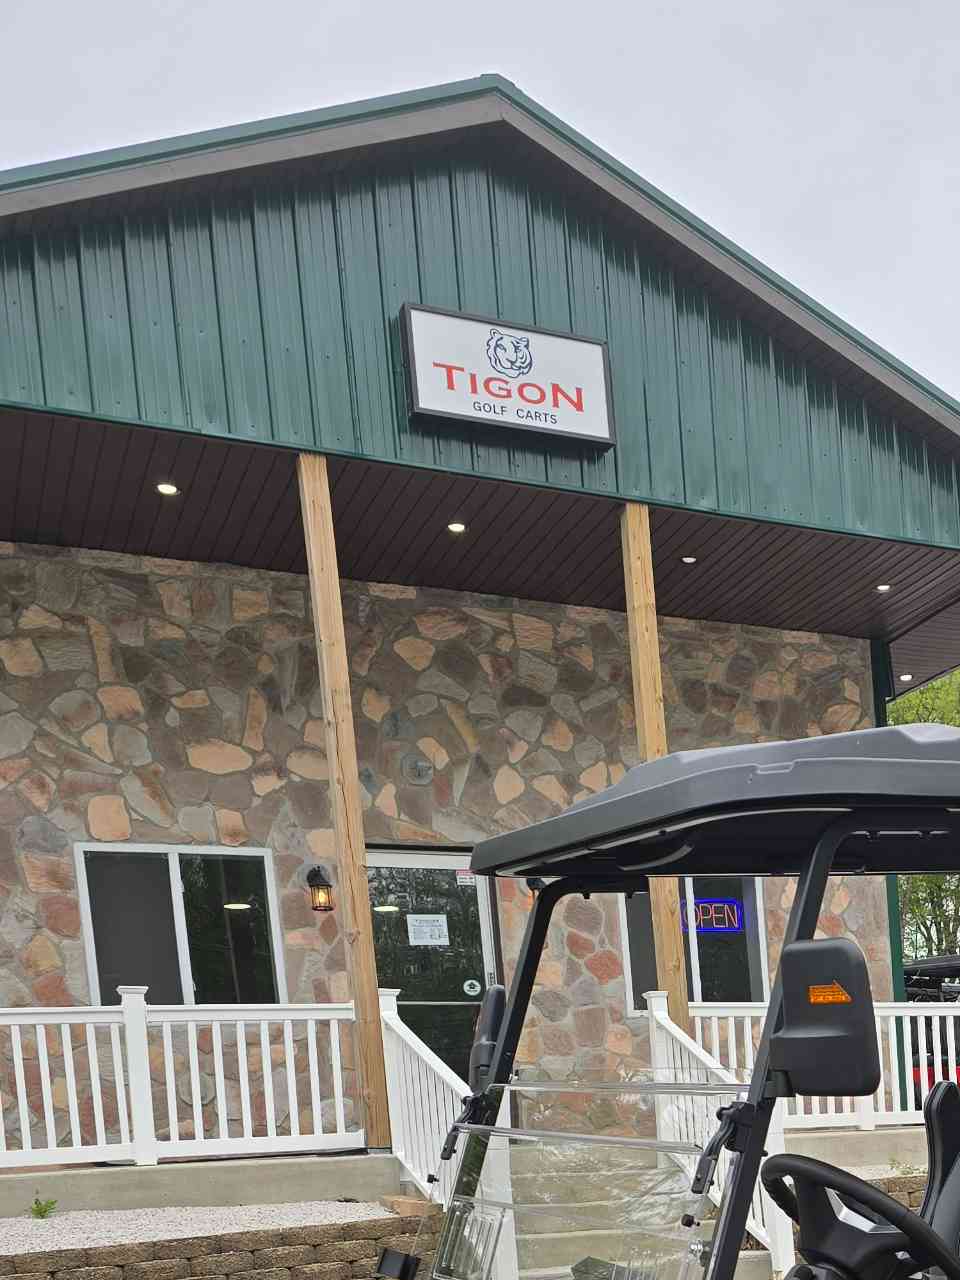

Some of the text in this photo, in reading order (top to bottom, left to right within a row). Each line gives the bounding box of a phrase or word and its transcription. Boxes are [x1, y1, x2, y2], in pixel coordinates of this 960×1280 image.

[432, 361, 584, 412] TIGON
[473, 401, 557, 424] GOLF CARTS
[683, 903, 739, 928] OPEN
